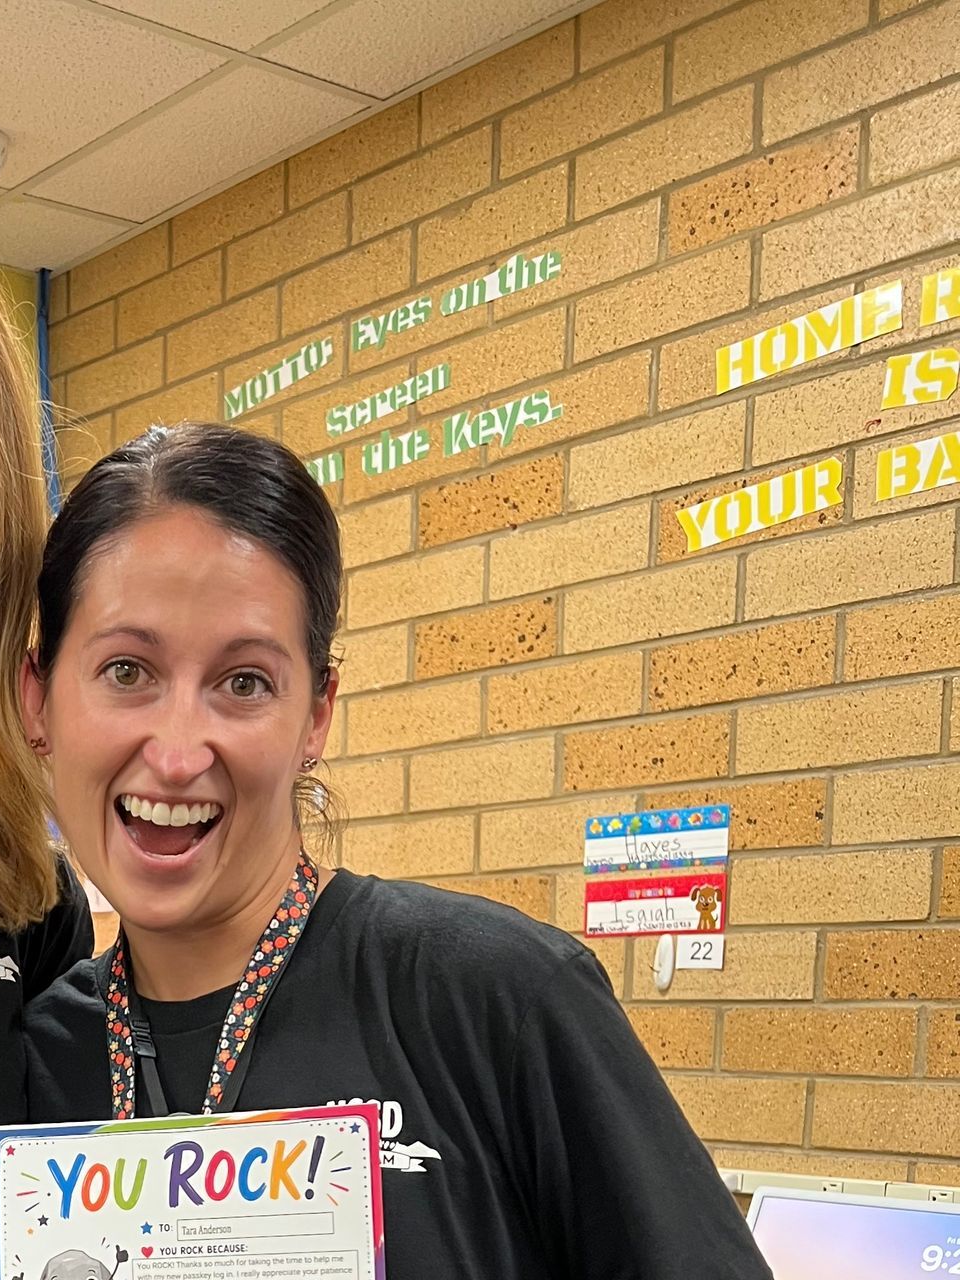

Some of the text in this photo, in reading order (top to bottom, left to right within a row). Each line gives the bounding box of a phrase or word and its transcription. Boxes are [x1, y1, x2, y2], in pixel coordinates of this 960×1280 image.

[352, 296, 431, 353] Eyes
[441, 278, 487, 316] on
[497, 251, 561, 294] the
[716, 280, 902, 395] HOME
[326, 362, 452, 437] Screen
[881, 348, 959, 410] IS
[362, 429, 429, 476] the
[443, 390, 563, 457] Keys.
[676, 457, 843, 552] YOUR
[625, 830, 681, 858] Hayes
[608, 898, 675, 924] Isaiah
[690, 941, 713, 960] 22
[47, 1135, 325, 1219] YOU ROCK!
[159, 1224, 231, 1236] TO: Tara Anderson
[160, 1244, 248, 1256] YOU ROCK BECAUSE:
[182, 1272, 211, 1280] passkey
[213, 1271, 224, 1279] log
[241, 1270, 260, 1278] really
[262, 1269, 300, 1277] appreciate
[320, 1267, 352, 1275] patience
[248, 1258, 271, 1266] taking
